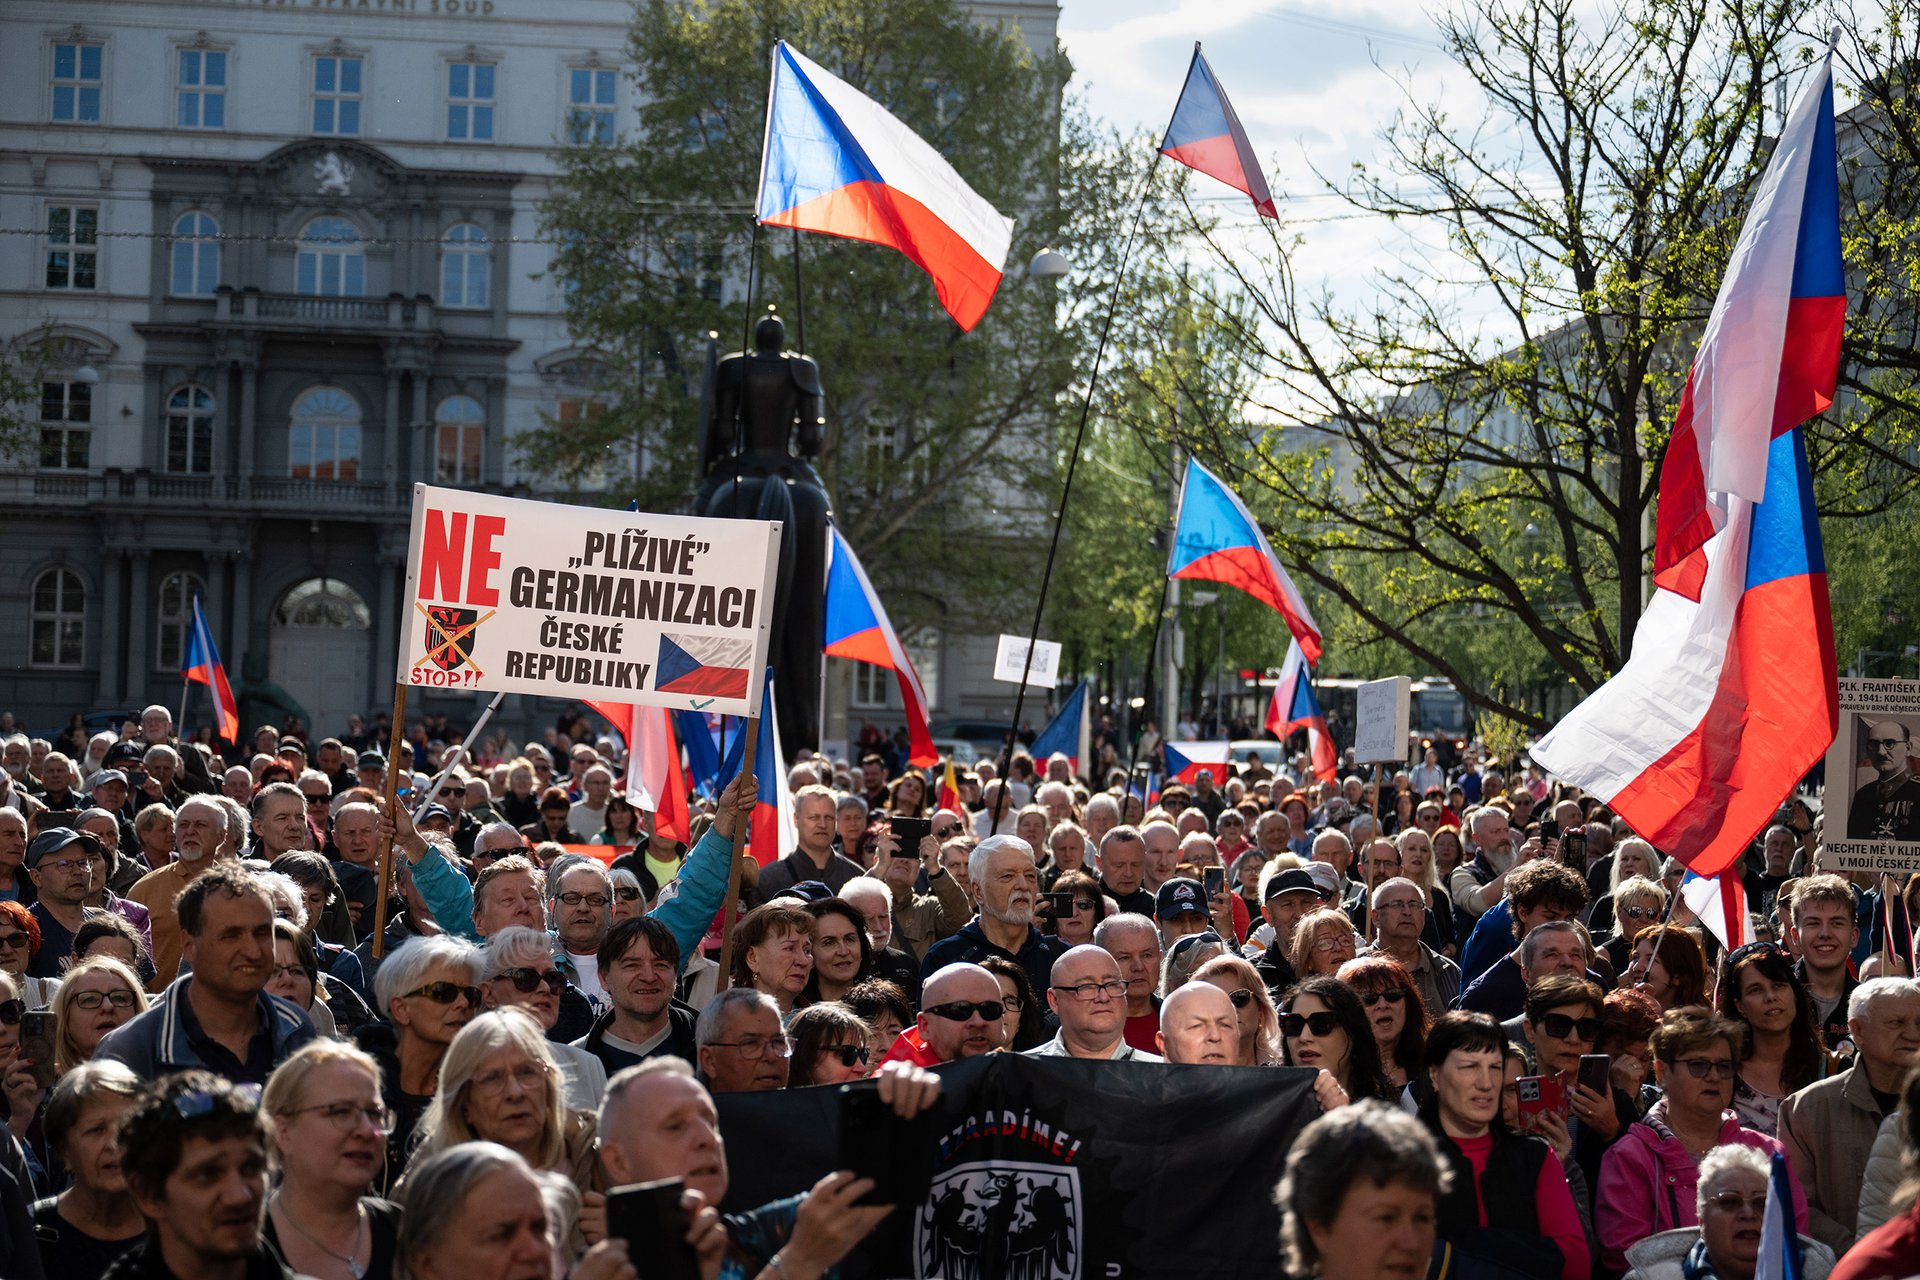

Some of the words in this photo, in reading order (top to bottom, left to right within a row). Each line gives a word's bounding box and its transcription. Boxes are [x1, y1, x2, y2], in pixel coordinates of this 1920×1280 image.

[431, 0, 494, 14] SOUD
[418, 509, 506, 607] NE
[509, 566, 756, 629] GERMANIZACI
[540, 615, 623, 654] ČESKÉ
[410, 667, 483, 687] STOP!!
[505, 651, 651, 690] REPUBLIKY
[1839, 682, 1860, 691] PLK.
[1863, 682, 1916, 693] FRANTIŠEK
[1848, 693, 1856, 701] 9.
[1859, 694, 1882, 702] 1941:
[1826, 843, 1867, 854] NECHTE
[1869, 842, 1886, 854] MĚ
[1889, 845, 1896, 855] V
[1839, 857, 1846, 867] V
[1848, 855, 1874, 867] MOJÍ
[1876, 856, 1910, 869] ČESKÉ
